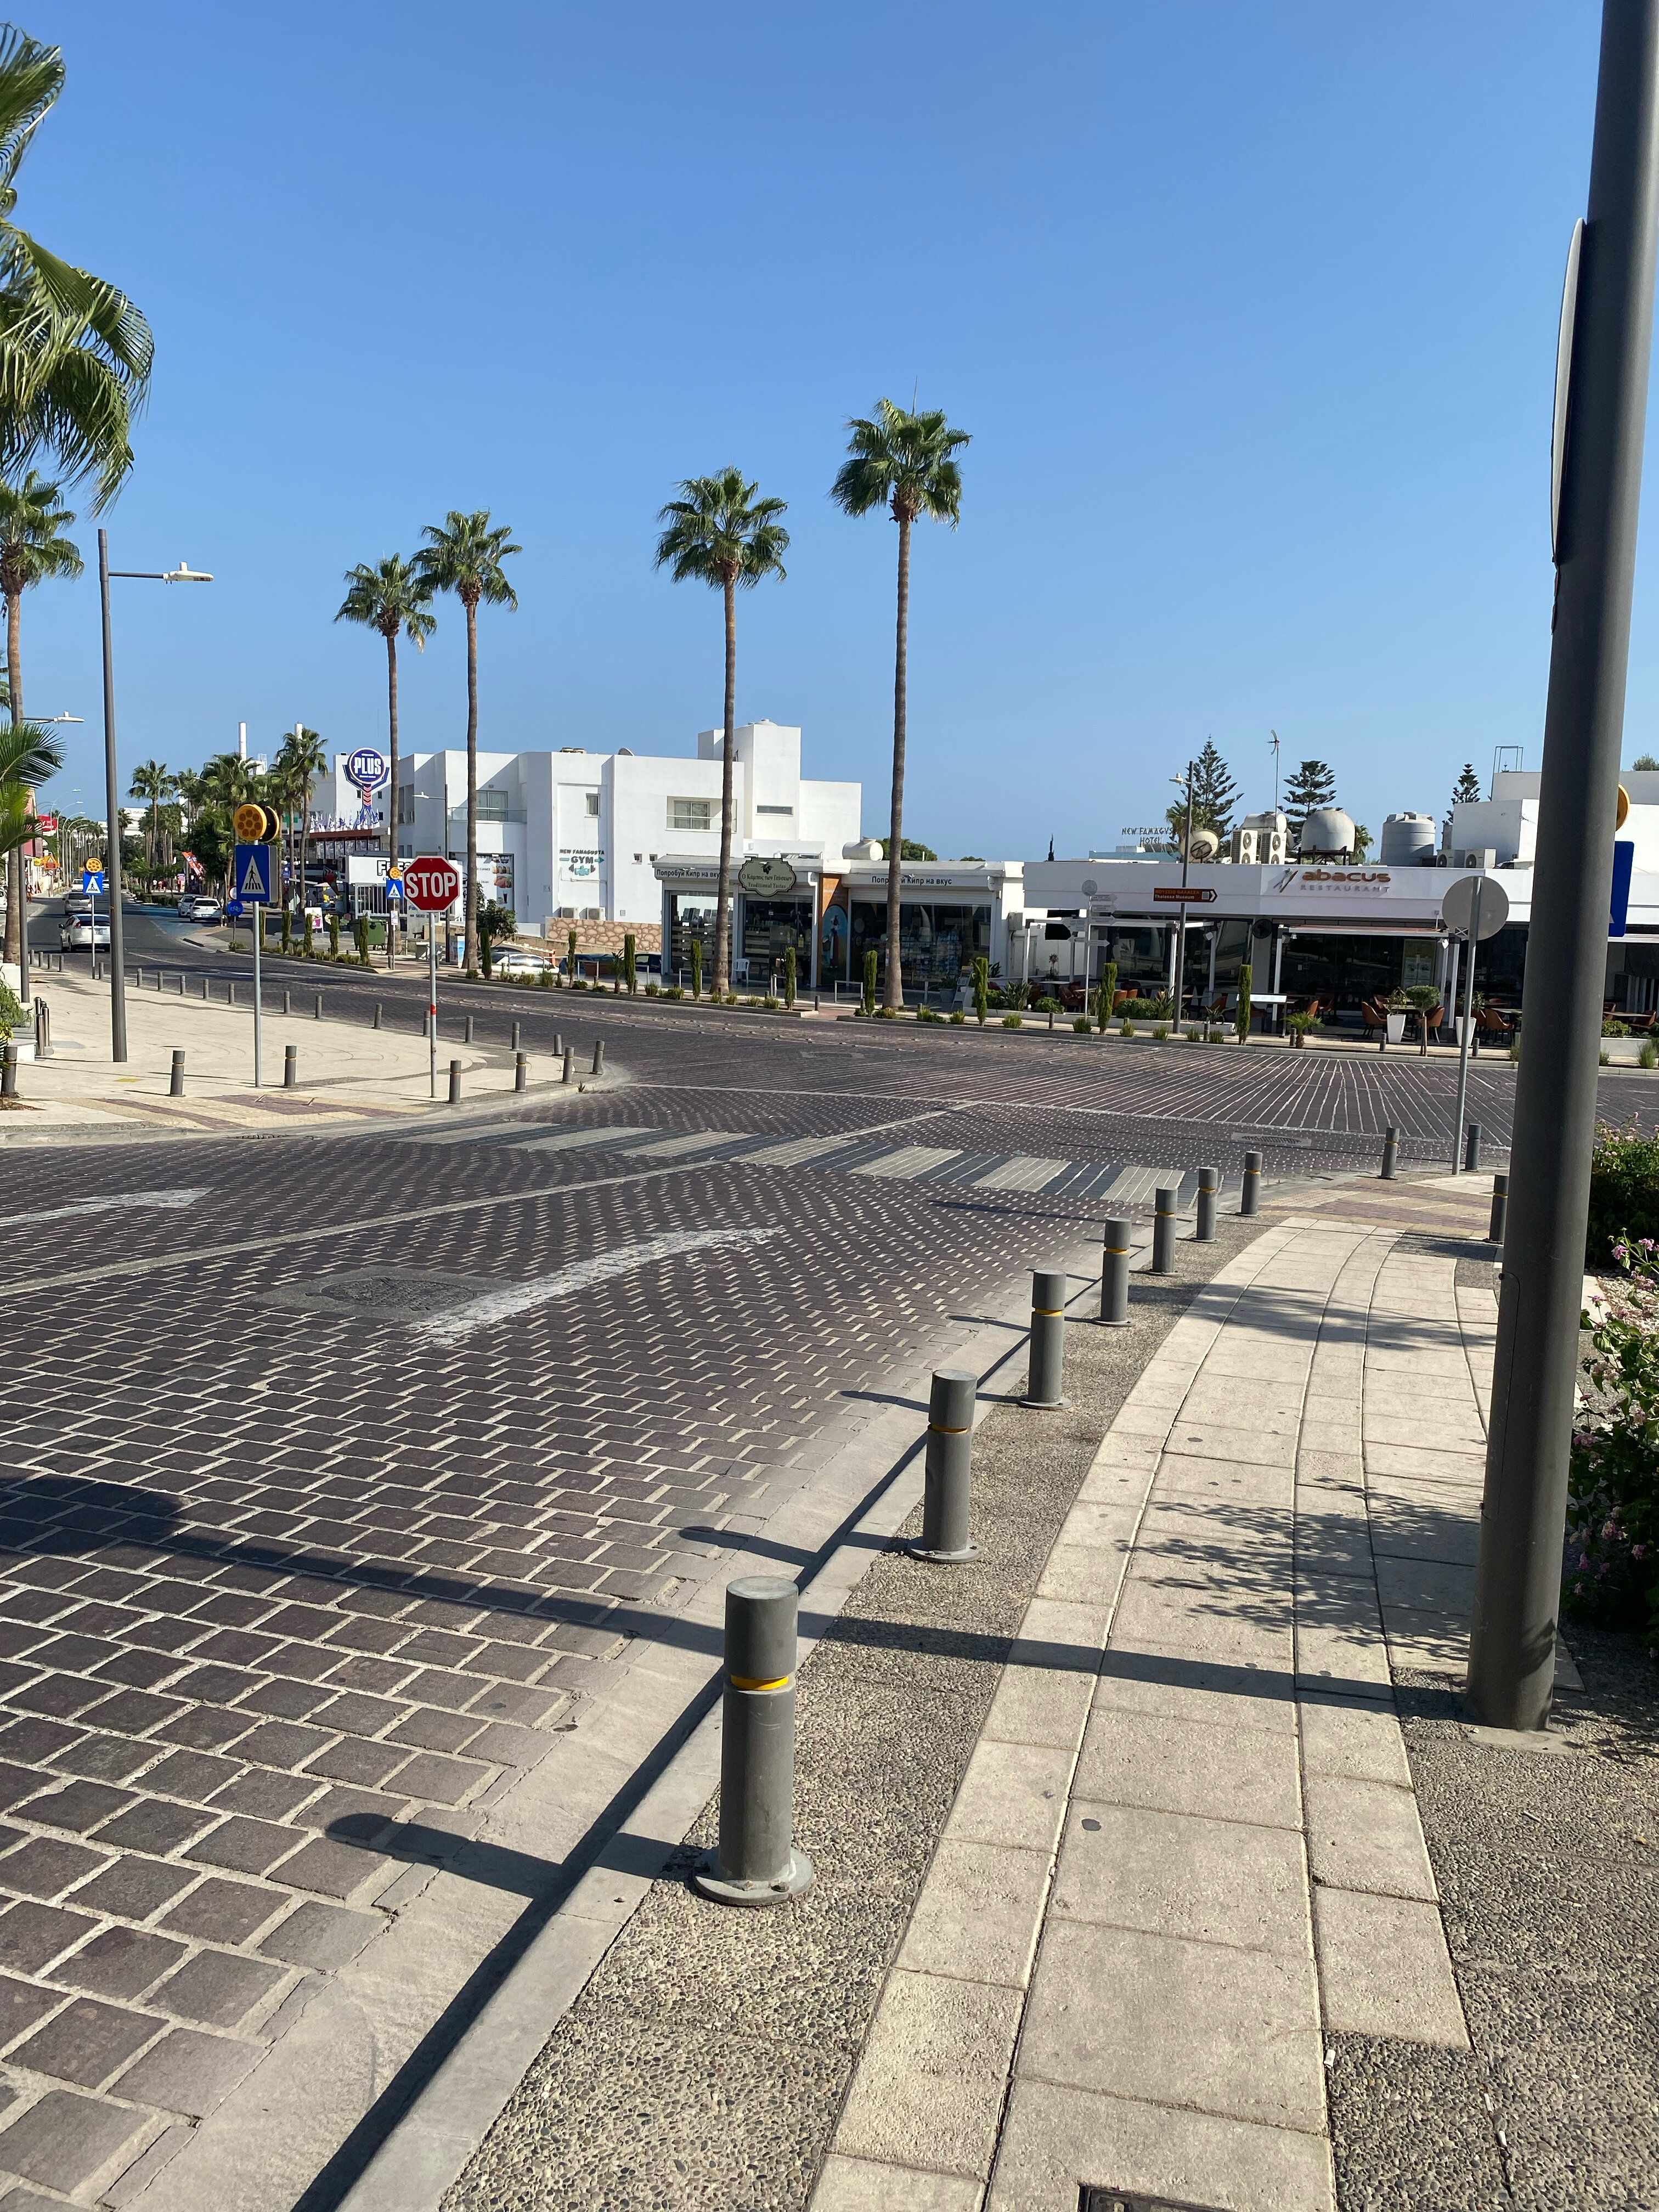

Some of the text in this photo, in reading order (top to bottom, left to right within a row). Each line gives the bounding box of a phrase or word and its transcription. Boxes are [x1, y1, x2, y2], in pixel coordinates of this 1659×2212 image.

[354, 757, 381, 775] PLUS
[1302, 869, 1391, 882] abacus
[406, 872, 456, 898] STOP
